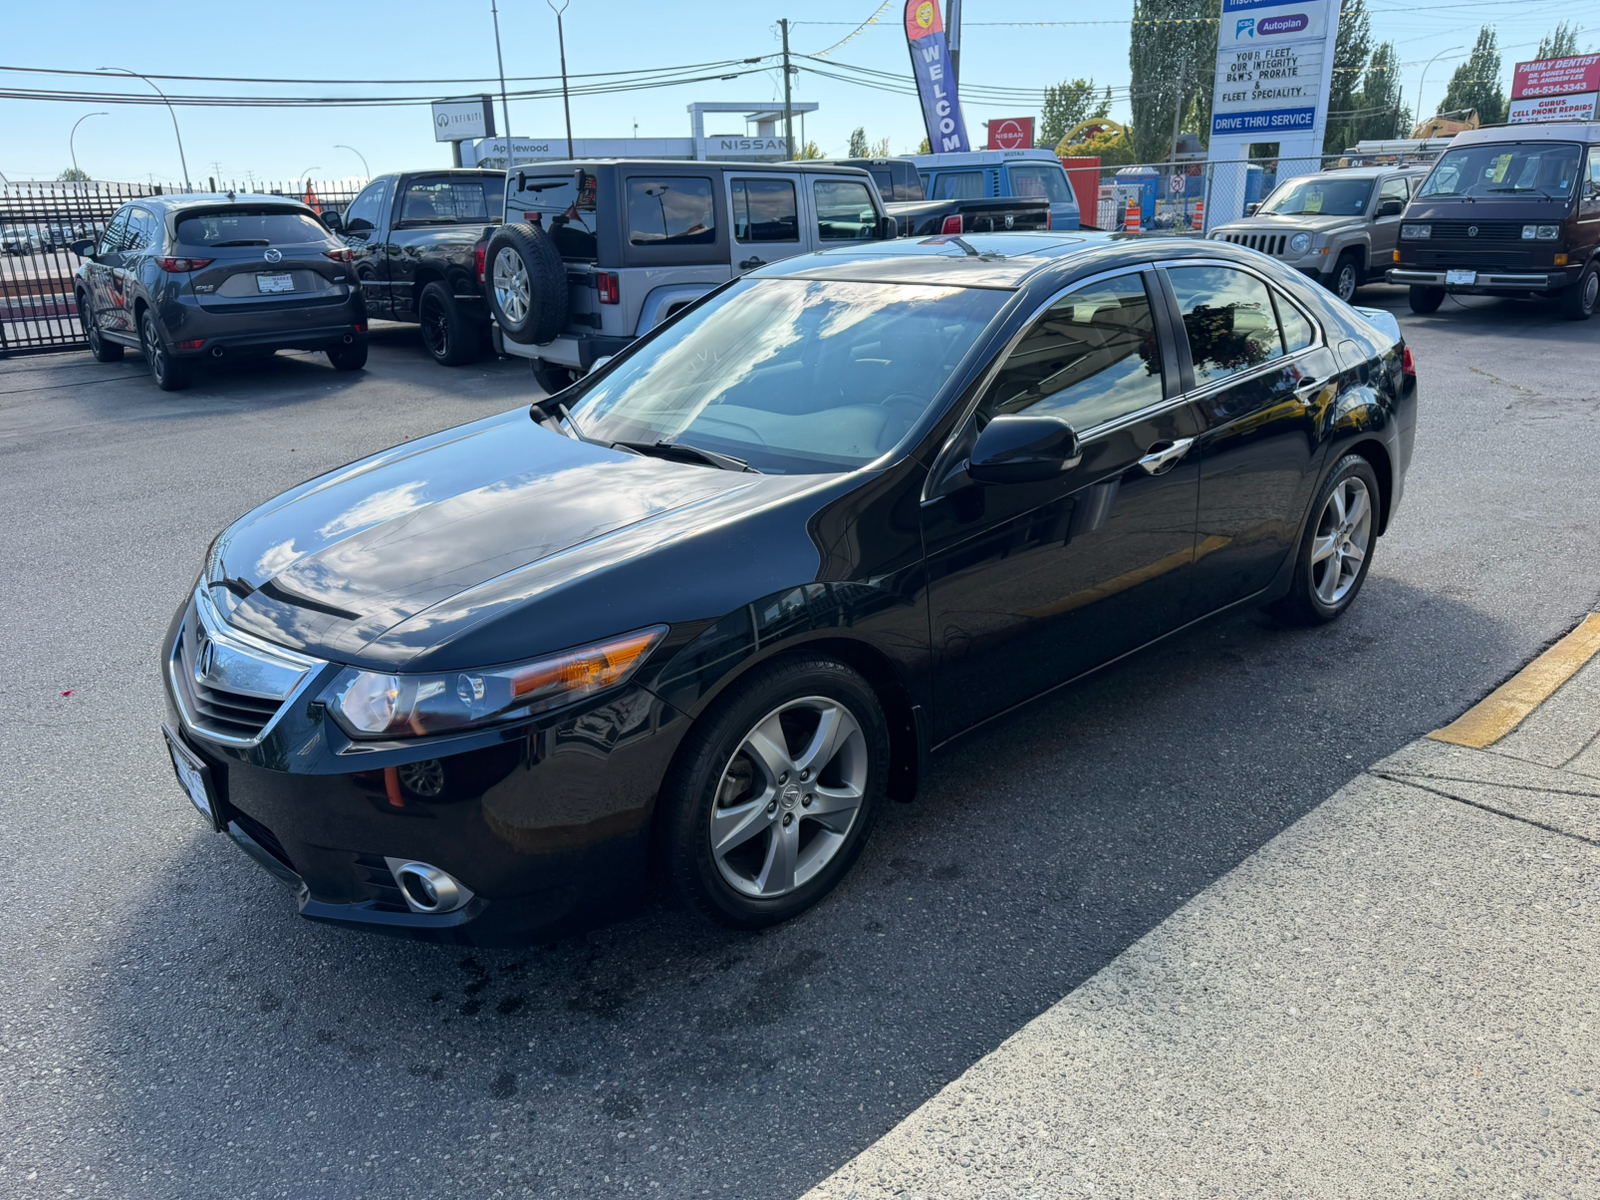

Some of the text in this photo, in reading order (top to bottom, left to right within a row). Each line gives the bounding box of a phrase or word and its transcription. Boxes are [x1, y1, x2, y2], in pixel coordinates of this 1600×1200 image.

[1263, 19, 1301, 31] Autoplan
[1236, 47, 1295, 61] YOUR FLEET.
[1230, 57, 1298, 72] OUR INTEGRITY
[1519, 56, 1599, 73] FAMILY DENTIST
[1226, 67, 1298, 82] B&W'S PRORATE
[1541, 69, 1564, 77] AGNES
[1565, 67, 1586, 75] CHAN
[1254, 81, 1260, 89] &
[1540, 75, 1570, 84] ANDREW
[1222, 87, 1307, 102] FLEET SPECIALITY.
[1522, 82, 1587, 96] 604-534-3343
[921, 44, 961, 153] WELCOM
[1538, 99, 1567, 108] GURUS
[1512, 103, 1593, 118] CELL PHONE REPAIRS
[451, 112, 482, 124] INFINITI
[1215, 113, 1312, 129] DRIVE THRU SERVICE
[492, 143, 549, 154] Aplewood
[721, 139, 787, 150] NISSAN
